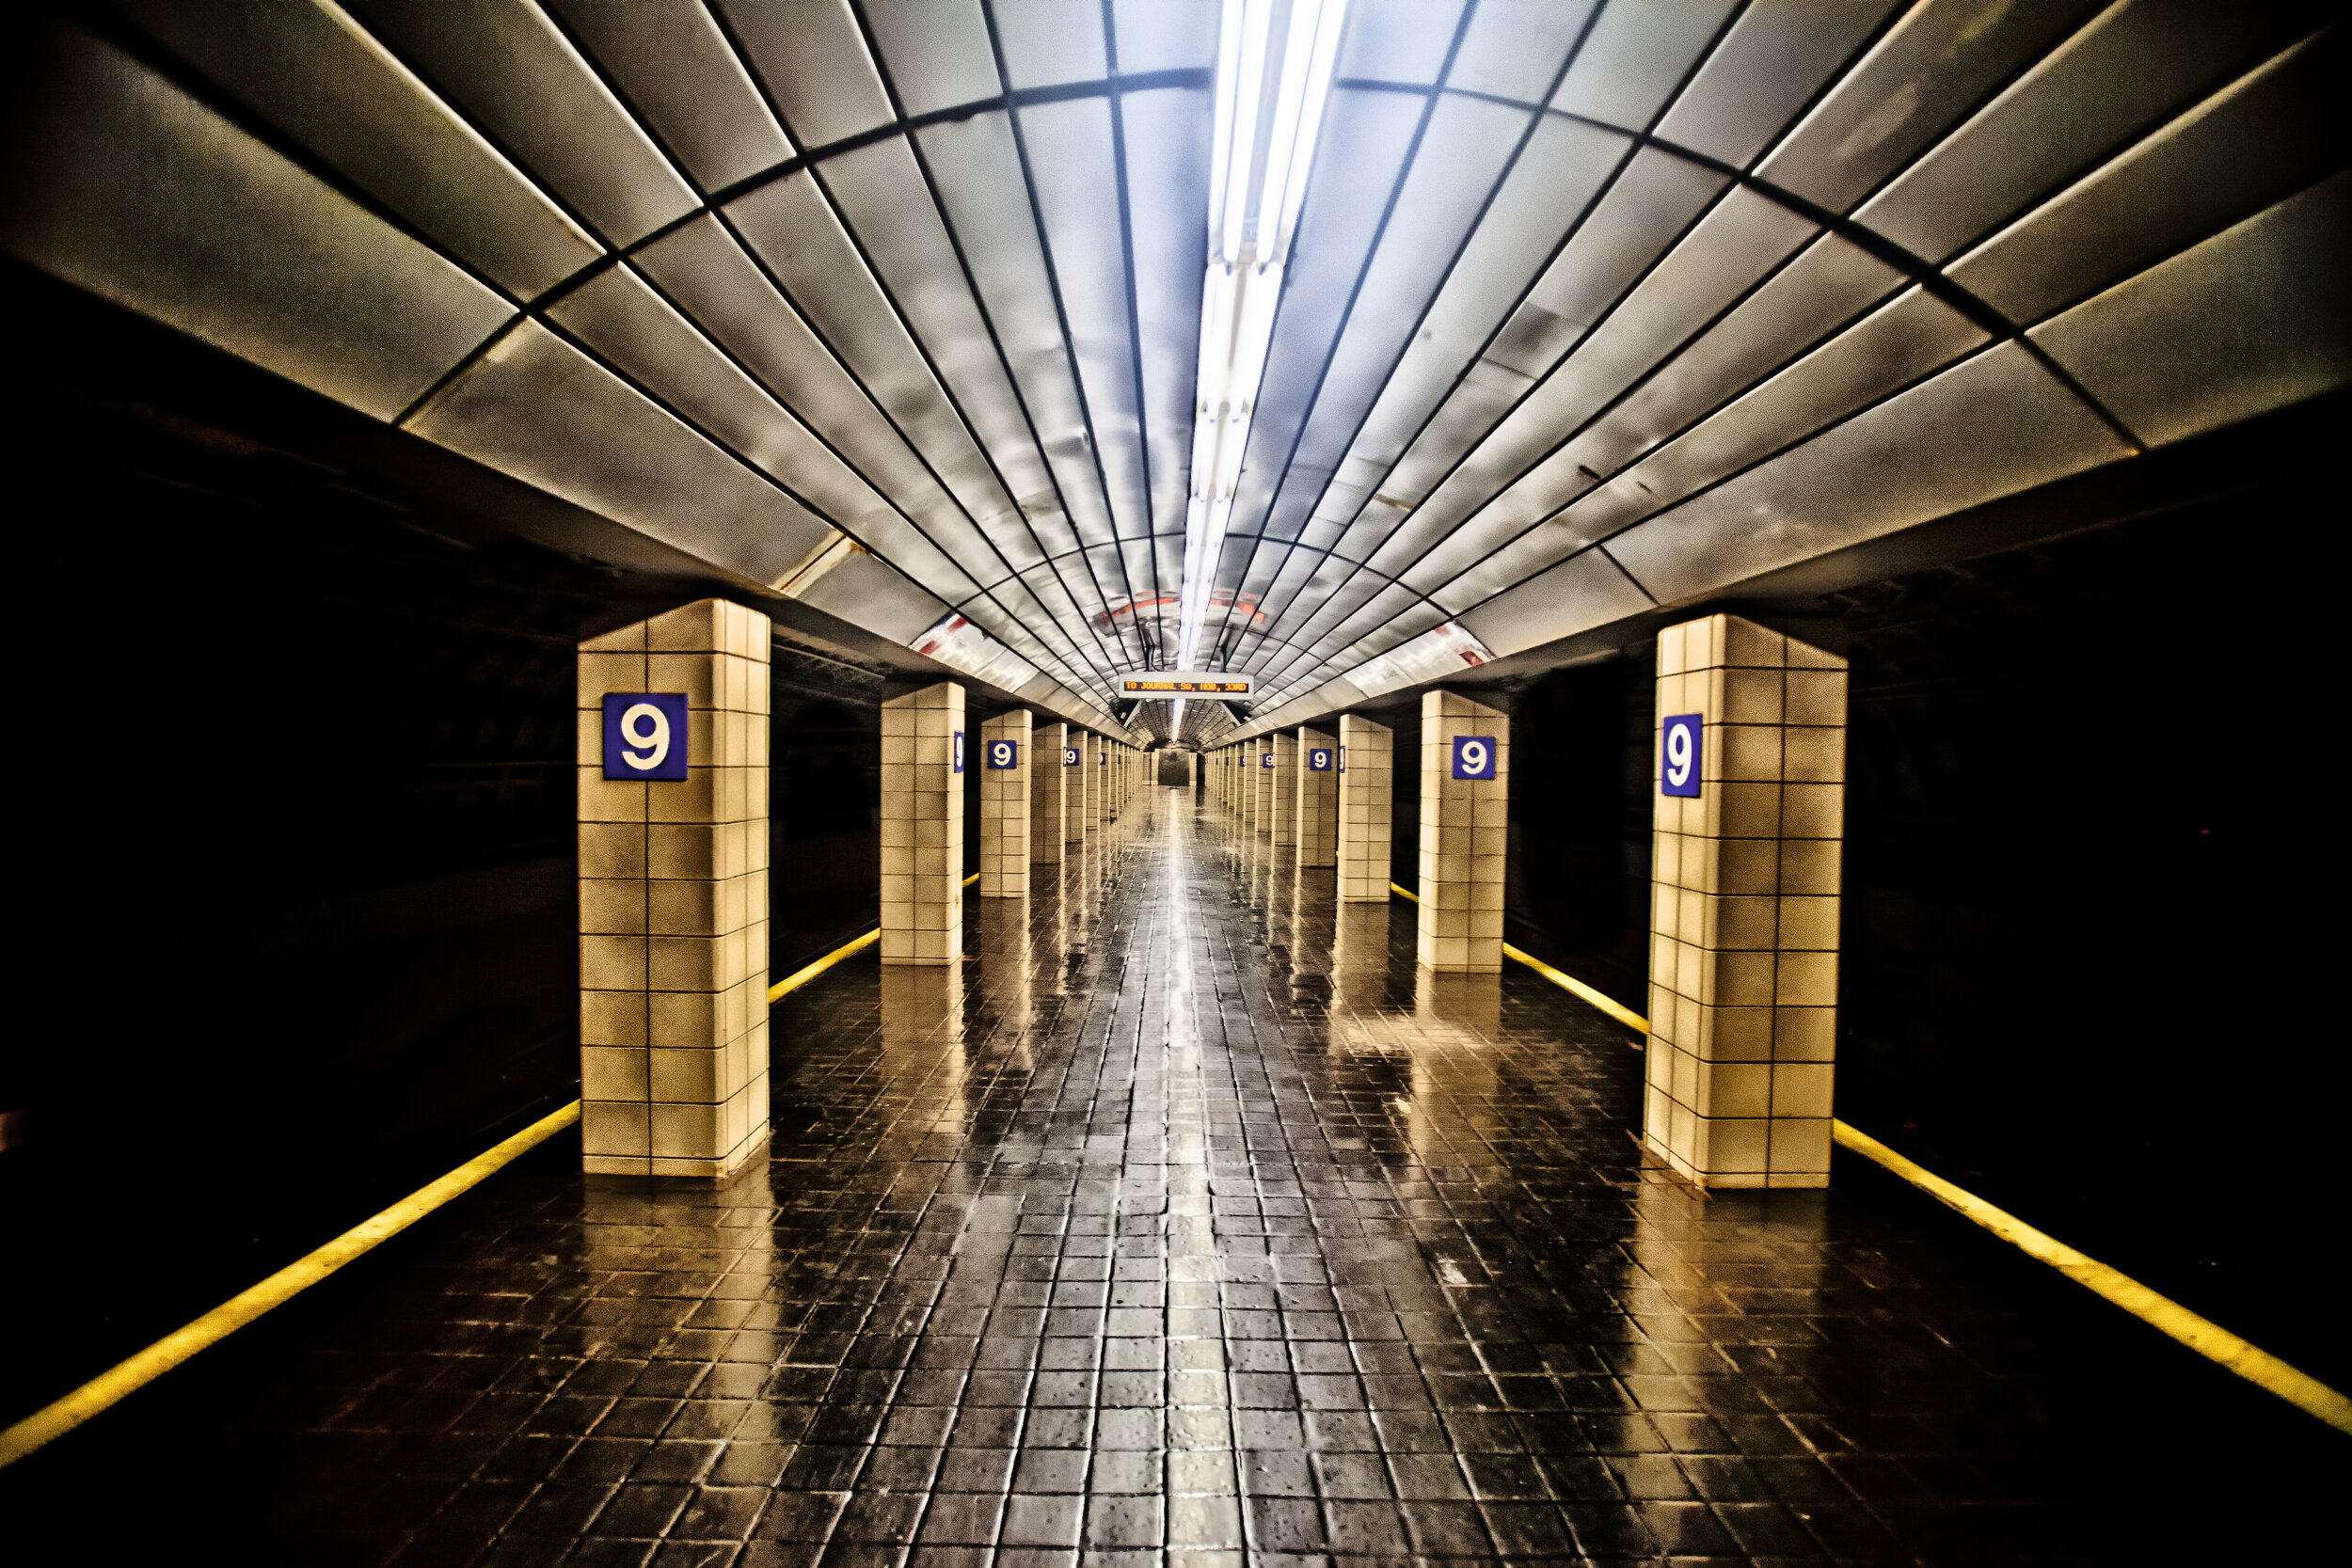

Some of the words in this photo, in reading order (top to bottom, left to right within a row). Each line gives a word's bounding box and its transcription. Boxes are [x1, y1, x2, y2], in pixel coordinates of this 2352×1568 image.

[1126, 681, 1137, 689] TO
[1141, 682, 1177, 690] JOURNAL
[1180, 683, 1196, 692] SQ,
[1225, 683, 1248, 691] 33RD
[621, 703, 670, 770] 9
[956, 736, 963, 768] 9
[993, 743, 1011, 767] 9
[1066, 751, 1075, 764] 9
[1265, 755, 1274, 766] 9
[1314, 752, 1327, 768] 9
[1461, 740, 1487, 775] 9
[1667, 723, 1692, 787] 9
